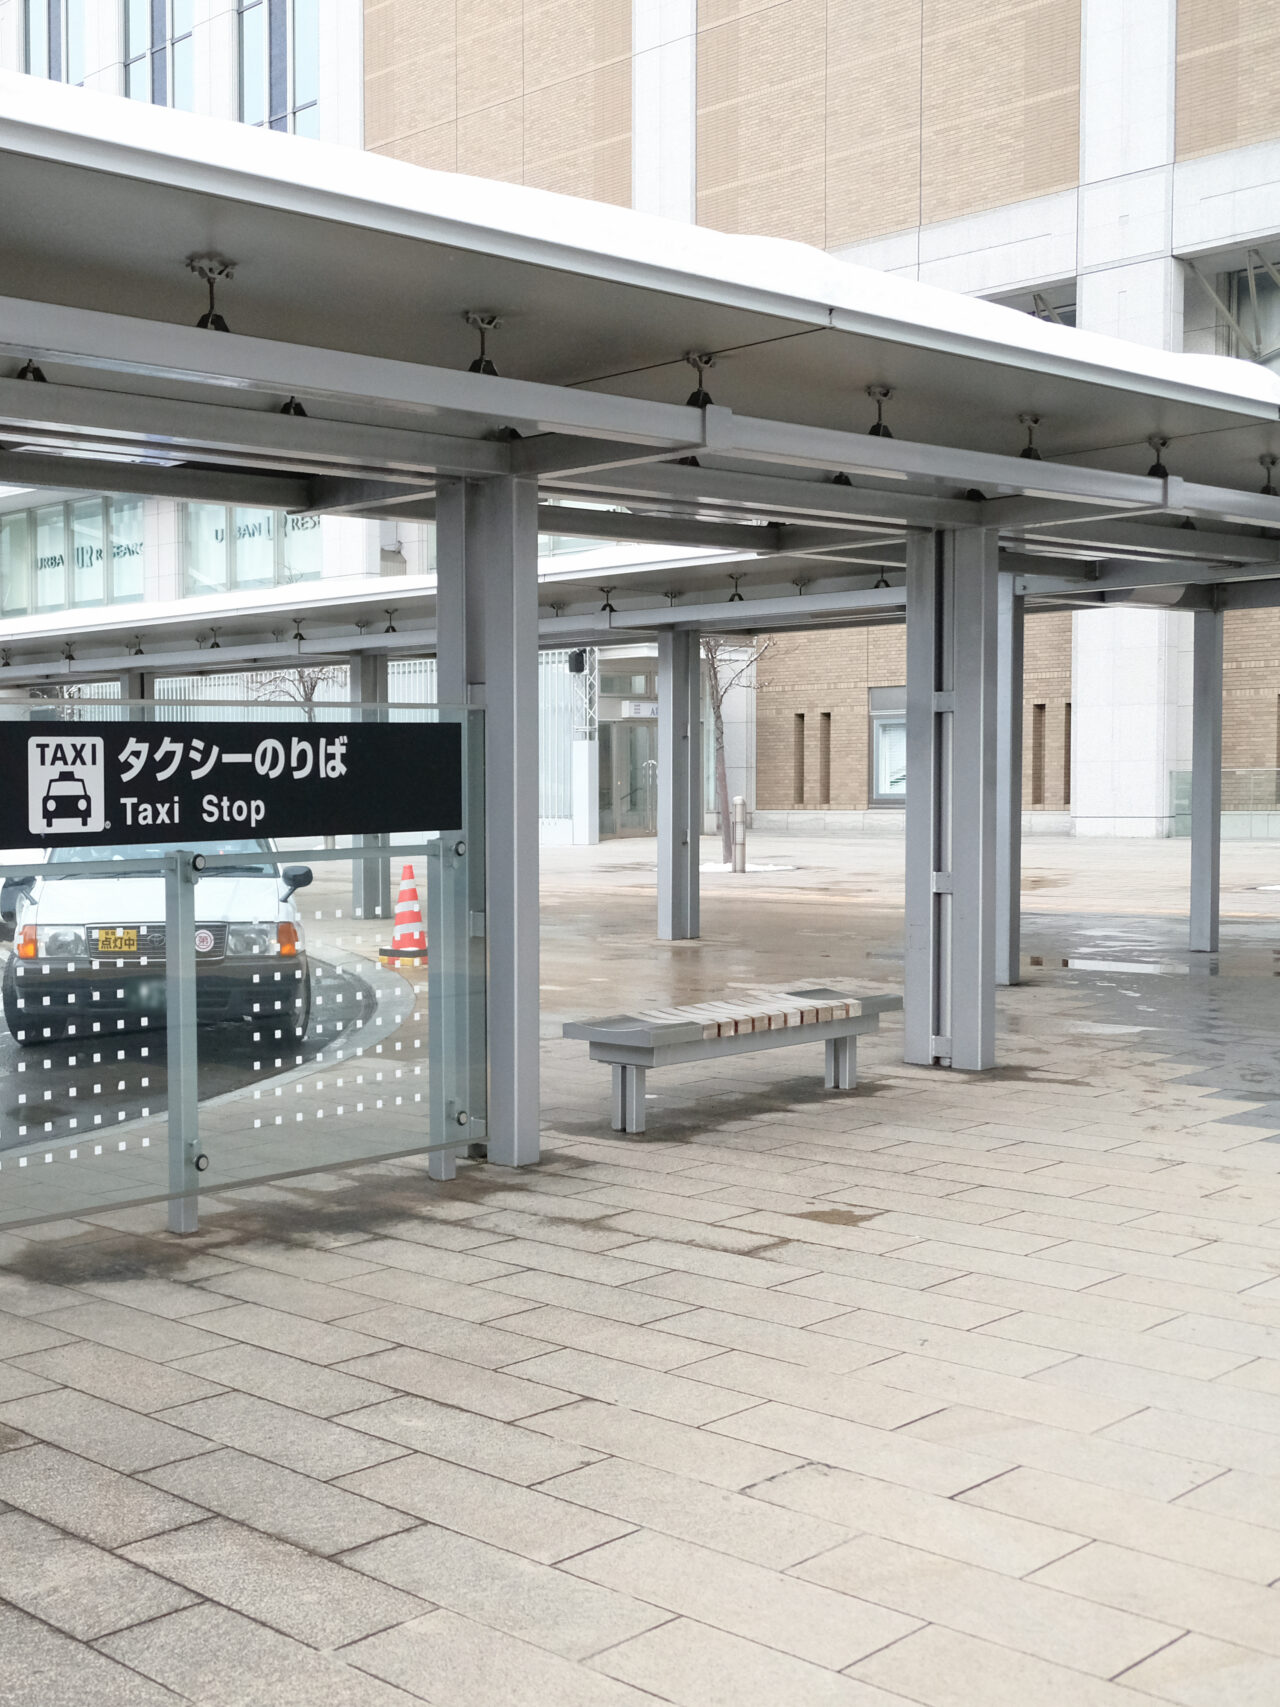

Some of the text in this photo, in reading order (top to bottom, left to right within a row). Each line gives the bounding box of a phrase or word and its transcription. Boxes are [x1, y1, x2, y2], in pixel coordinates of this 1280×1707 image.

[35, 554, 65, 570] URBA
[35, 743, 97, 767] TAXI
[118, 735, 348, 783] タクシーのりば
[119, 794, 266, 828] Taxi Stop
[101, 936, 135, 950] 点灯中
